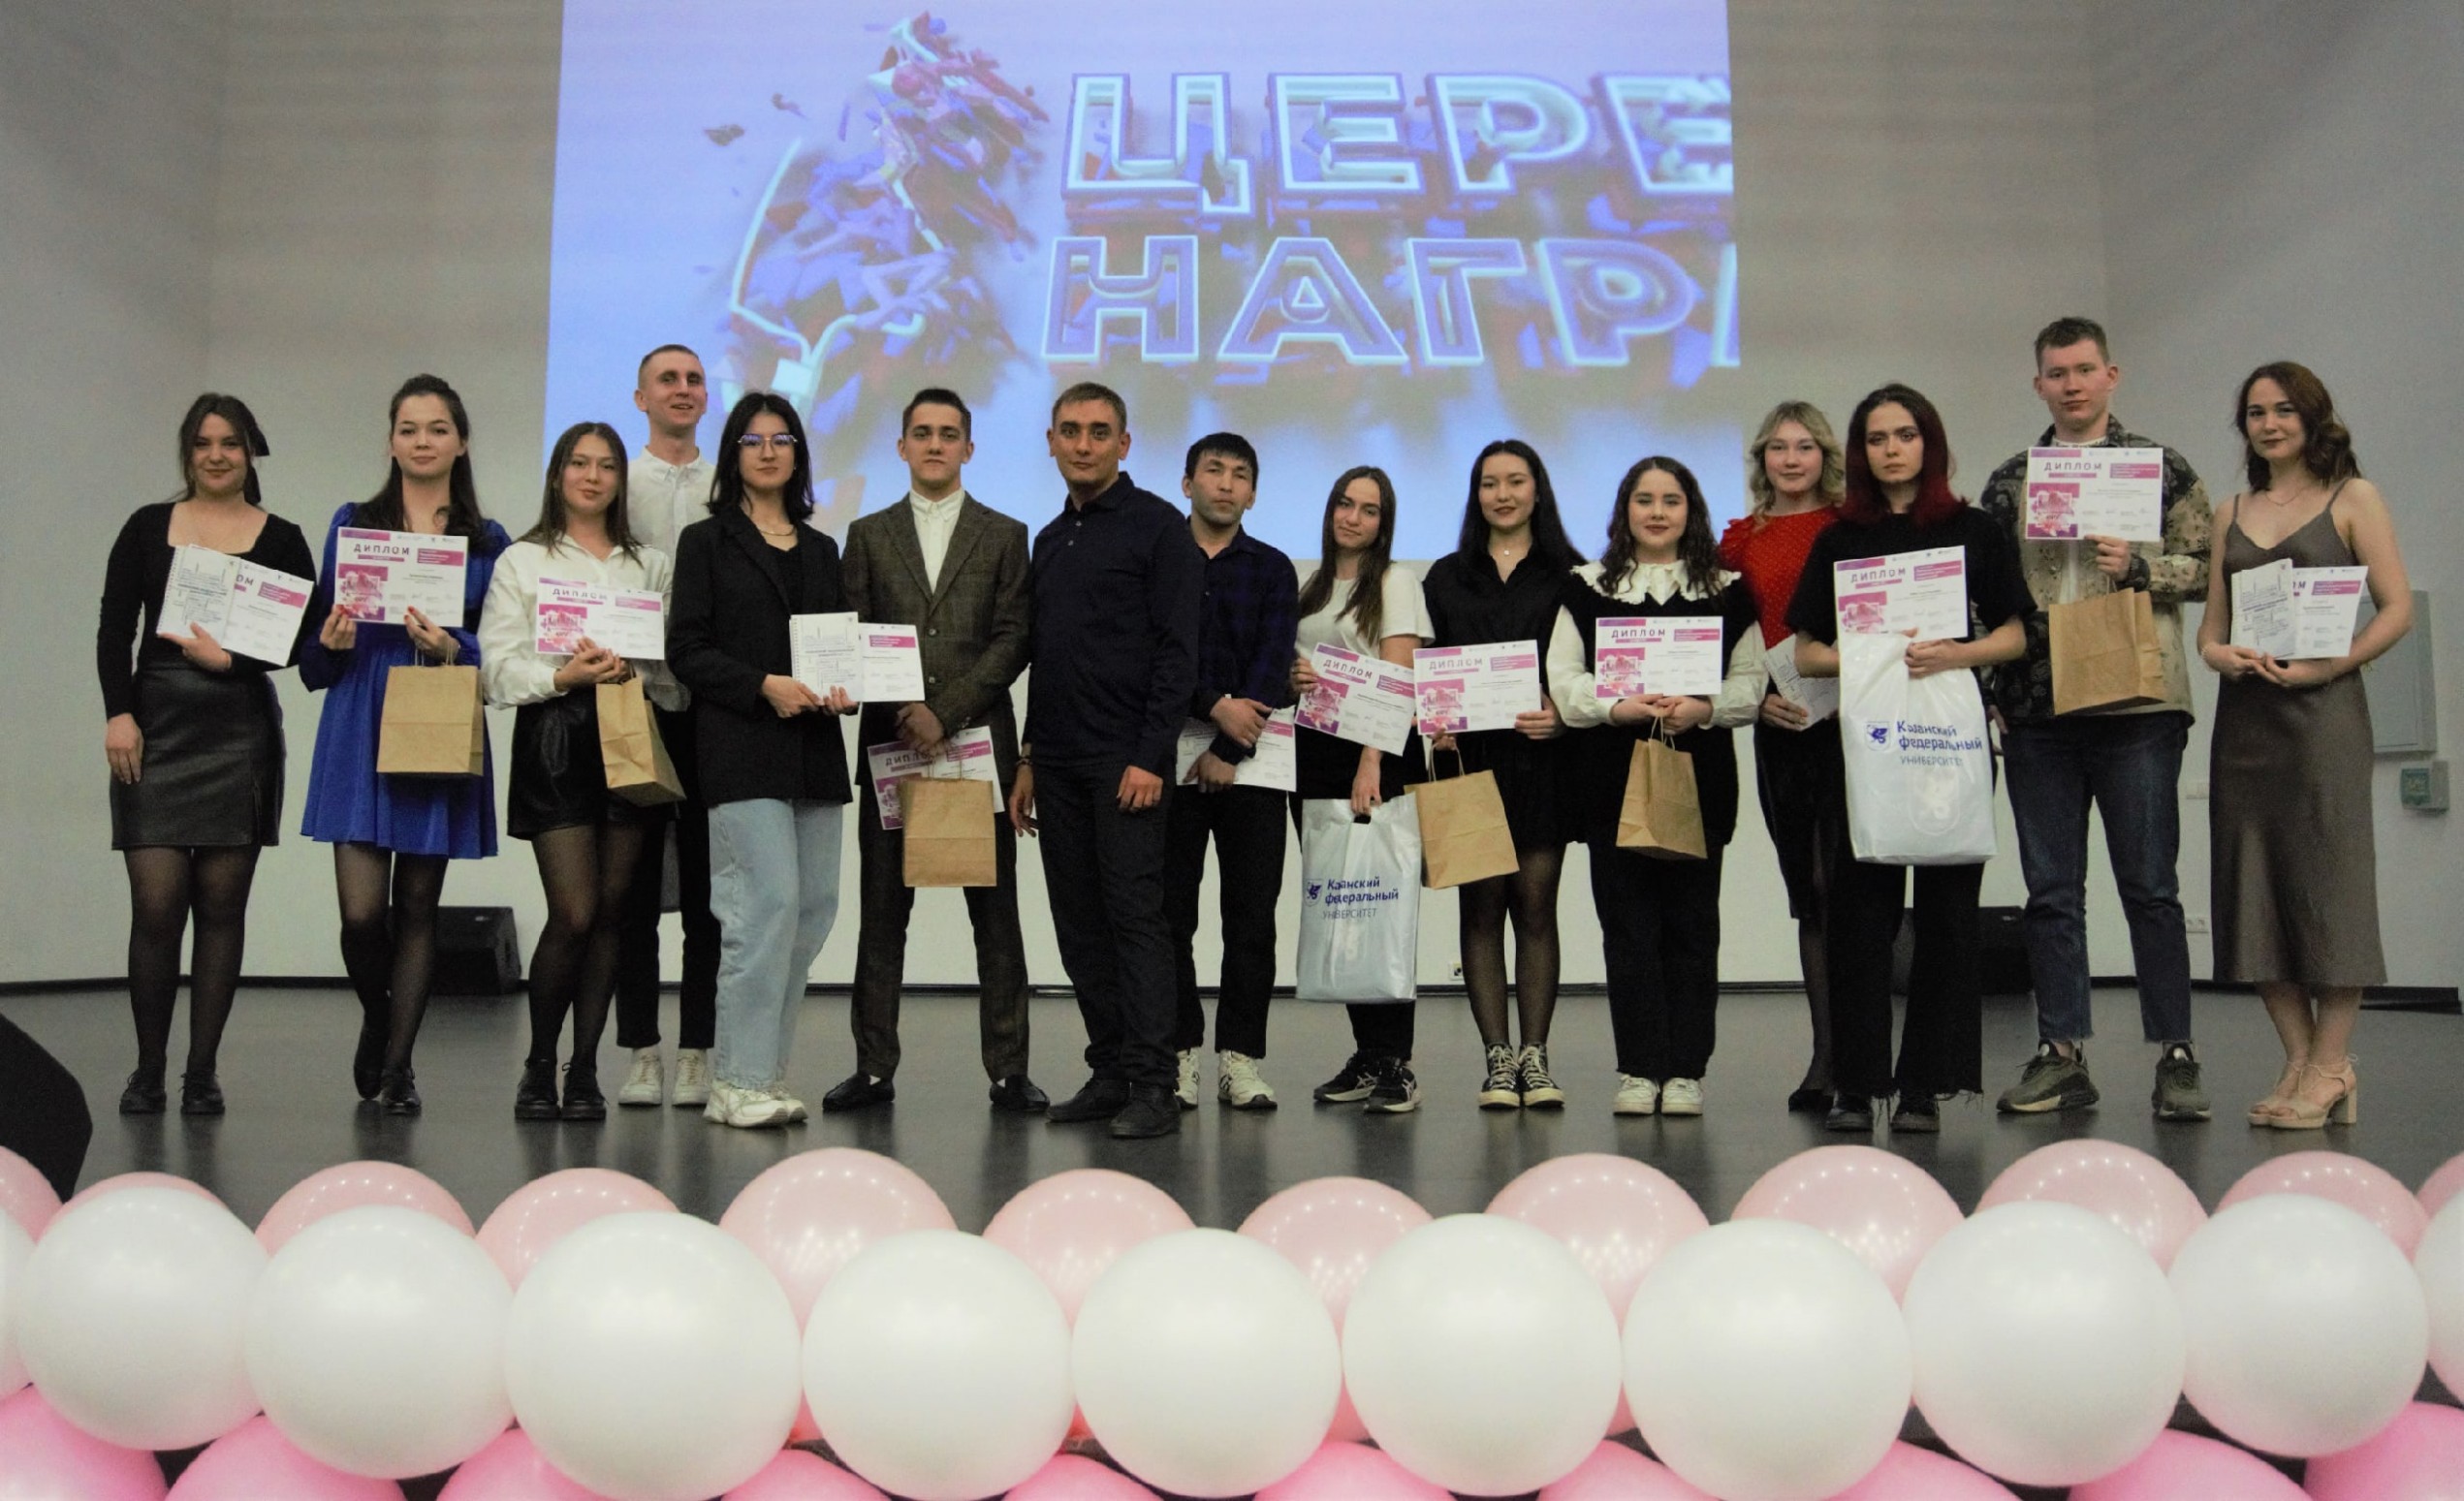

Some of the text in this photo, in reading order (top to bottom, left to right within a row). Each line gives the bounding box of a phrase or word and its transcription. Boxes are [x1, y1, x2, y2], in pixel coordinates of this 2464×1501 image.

[1041, 235, 1741, 366] НАГР
[2043, 462, 2102, 472] ДИПЛОМ
[353, 544, 410, 555] ДИПЛОМ
[1850, 568, 1906, 583] ДИПЛОМ
[1611, 629, 1666, 639] ДИПЛОМ
[1323, 659, 1373, 679] ДИПЛОМ
[1429, 658, 1483, 670] ДИПЛОМ
[1899, 735, 1983, 751] федеральный
